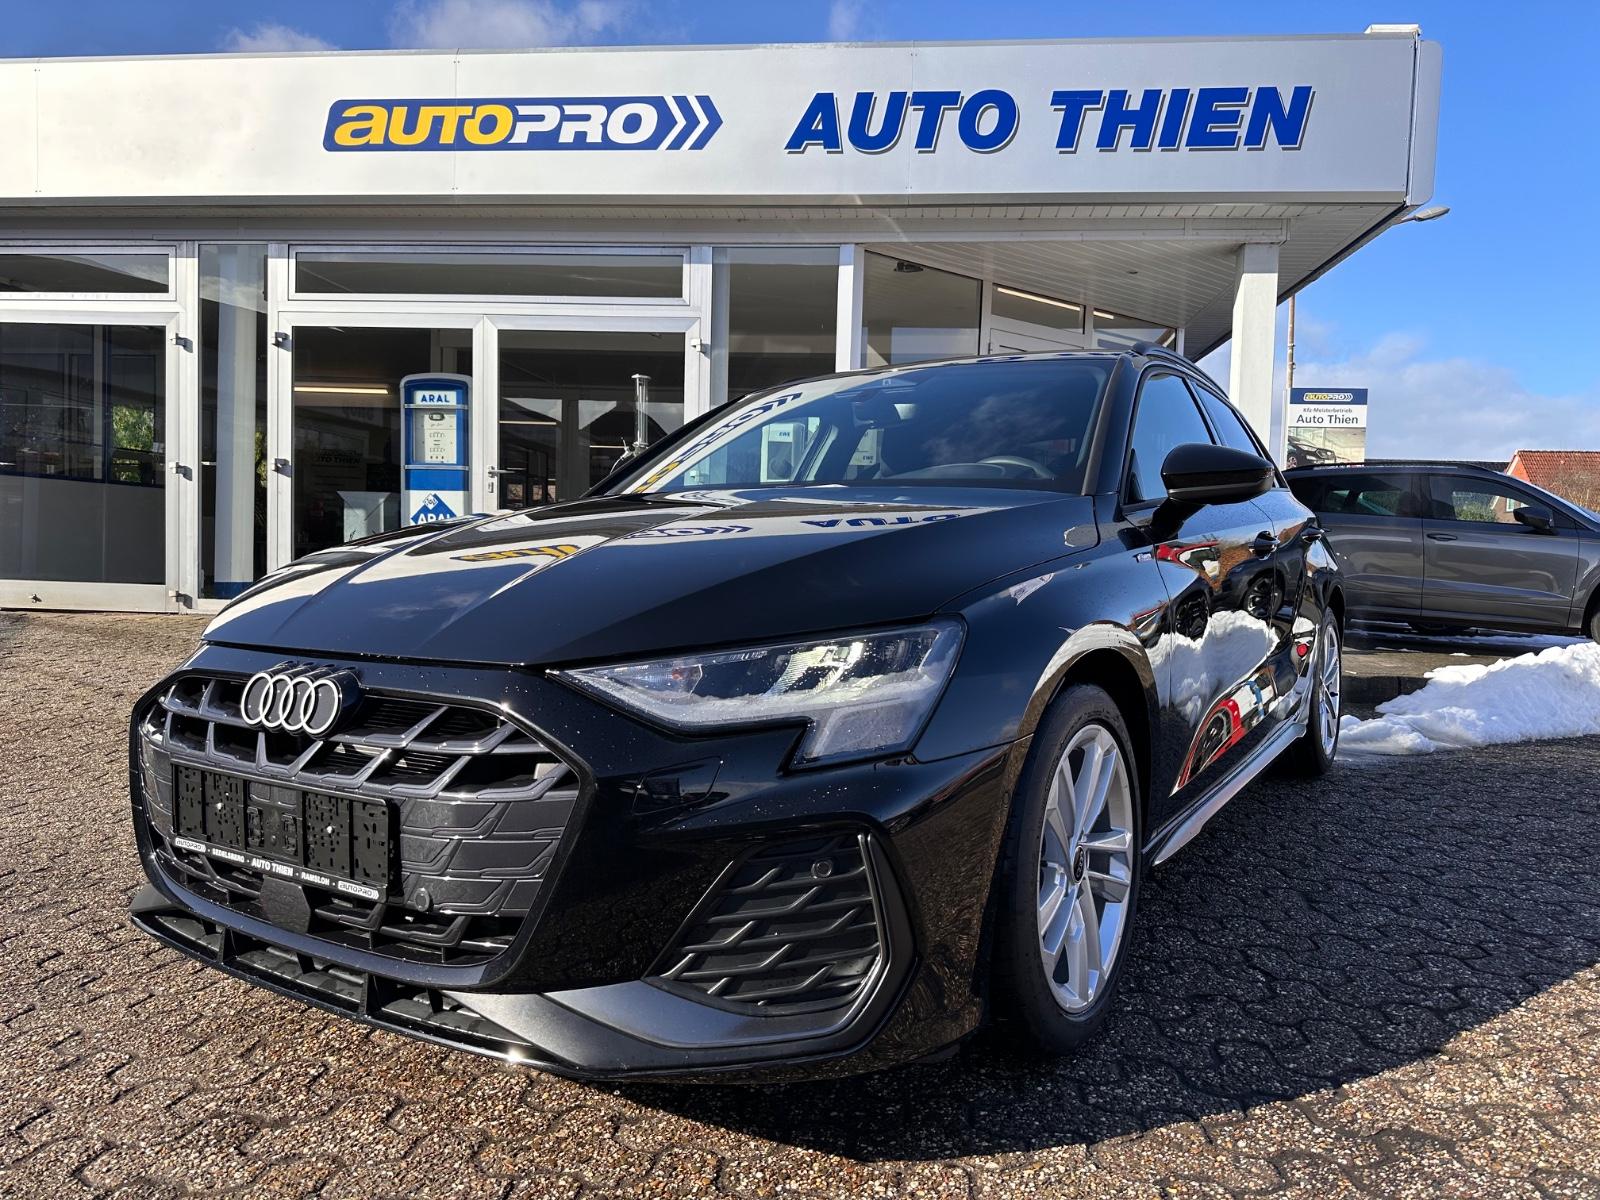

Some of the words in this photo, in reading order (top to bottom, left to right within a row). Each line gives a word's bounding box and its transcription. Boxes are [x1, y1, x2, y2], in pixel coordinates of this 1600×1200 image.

[784, 88, 1021, 154] AUTO
[1050, 85, 1316, 153] THIEN
[420, 394, 450, 403] ARAL
[1296, 414, 1324, 424] Auto
[1327, 414, 1358, 424] Thien
[251, 857, 271, 870] AUTO
[271, 863, 294, 877] THIEN
